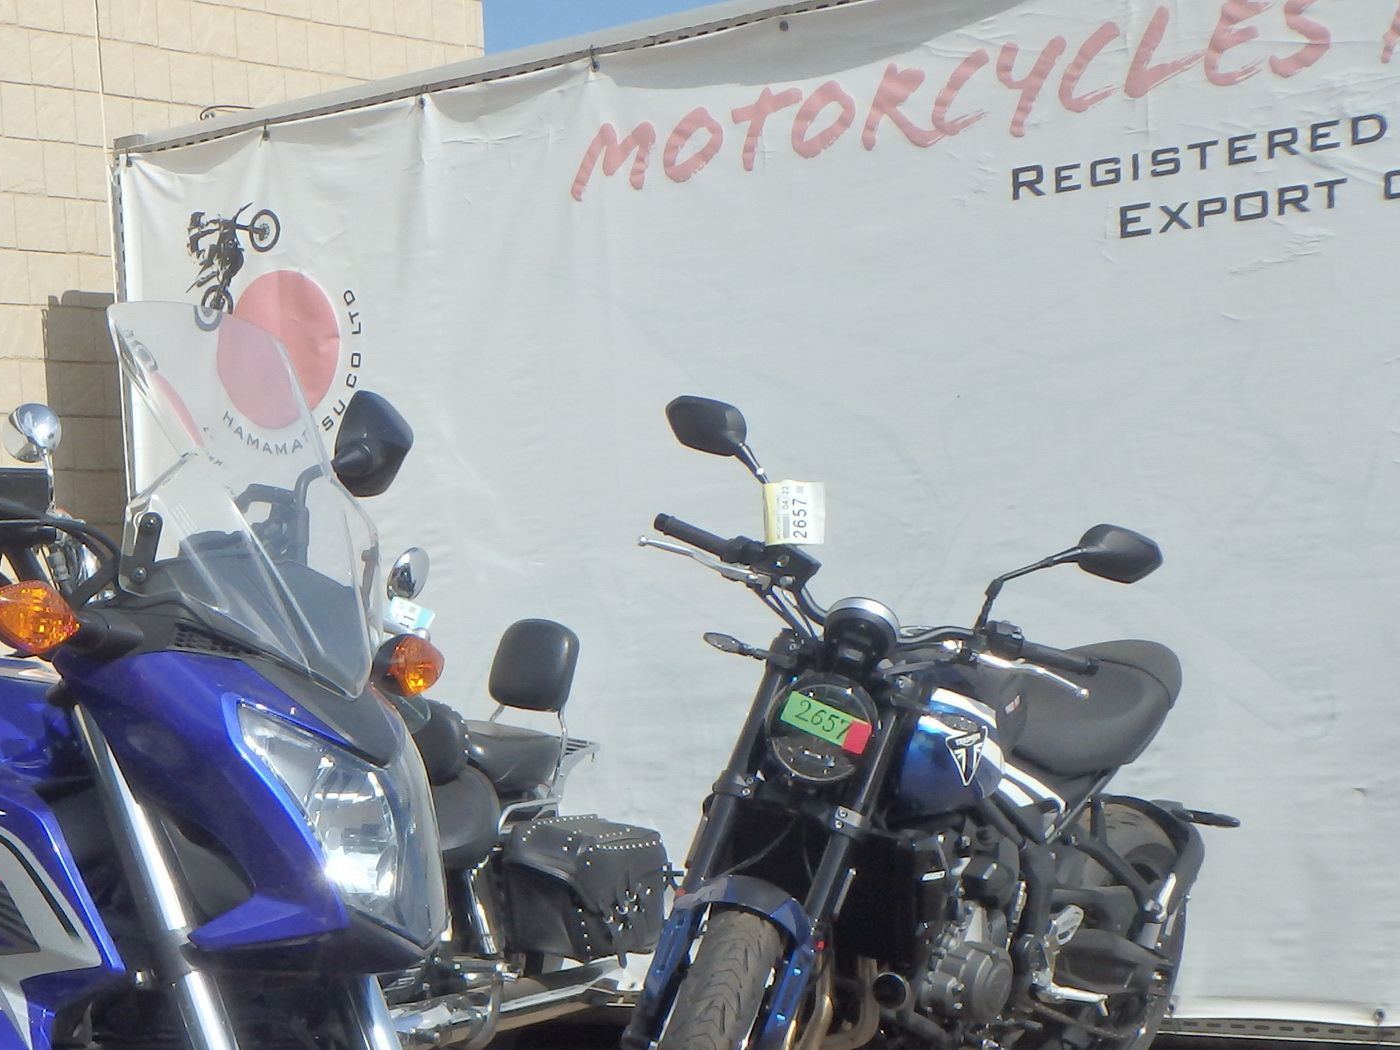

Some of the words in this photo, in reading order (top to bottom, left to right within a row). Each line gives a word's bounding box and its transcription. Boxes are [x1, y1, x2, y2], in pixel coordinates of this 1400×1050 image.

[571, 0, 1331, 202] MOTORCYCLES
[1011, 113, 1388, 201] REGISTERED
[1119, 177, 1348, 240] EXPORT
[343, 289, 362, 335] LTD
[345, 352, 362, 388] CO
[792, 498, 808, 539] 2657
[794, 699, 853, 740] 2657
